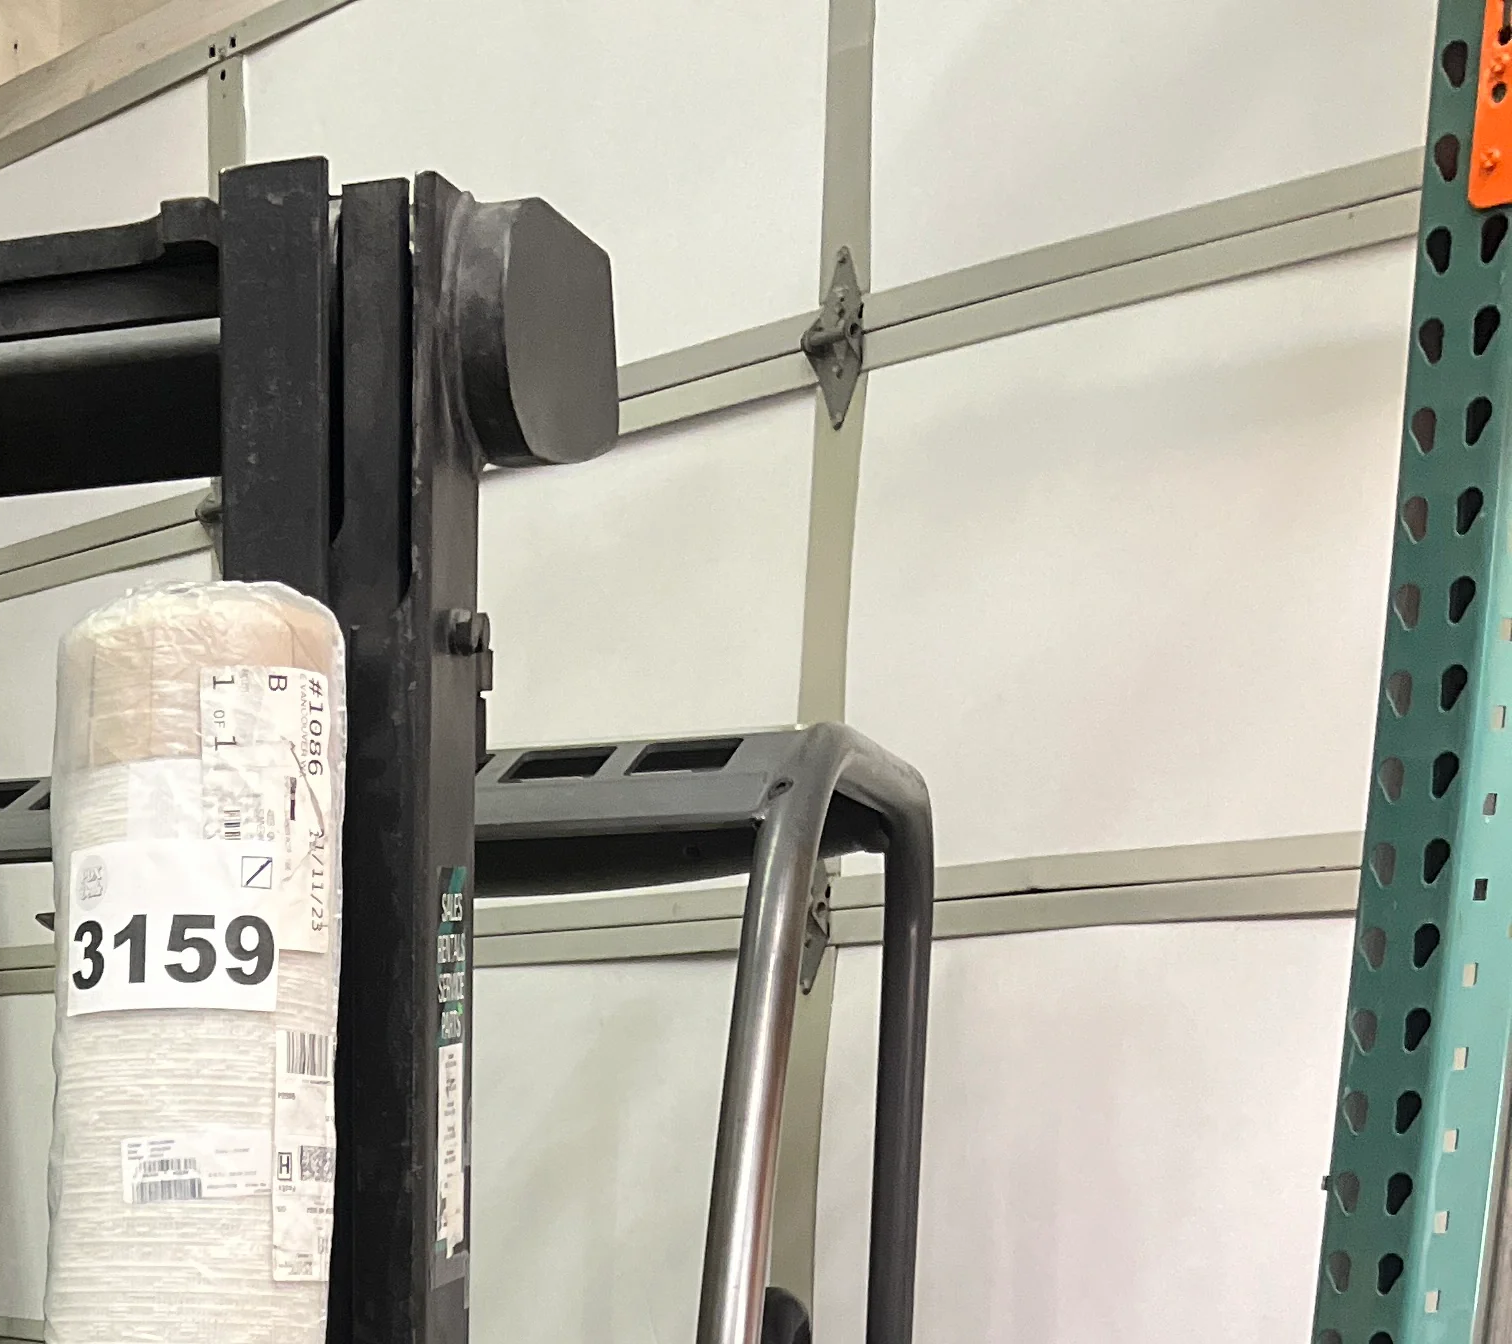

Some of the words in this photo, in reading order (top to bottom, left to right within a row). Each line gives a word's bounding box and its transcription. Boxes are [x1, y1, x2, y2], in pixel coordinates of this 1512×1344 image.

[212, 675, 235, 690] 1
[268, 674, 288, 692] B
[213, 709, 226, 729] OF
[307, 677, 325, 776] #1086
[214, 735, 237, 751] 1
[441, 893, 463, 922] SALES
[72, 913, 275, 991] 3159
[437, 933, 466, 964] RENTALS
[438, 971, 465, 1003] SERVICE
[441, 1010, 462, 1039] PARTS
